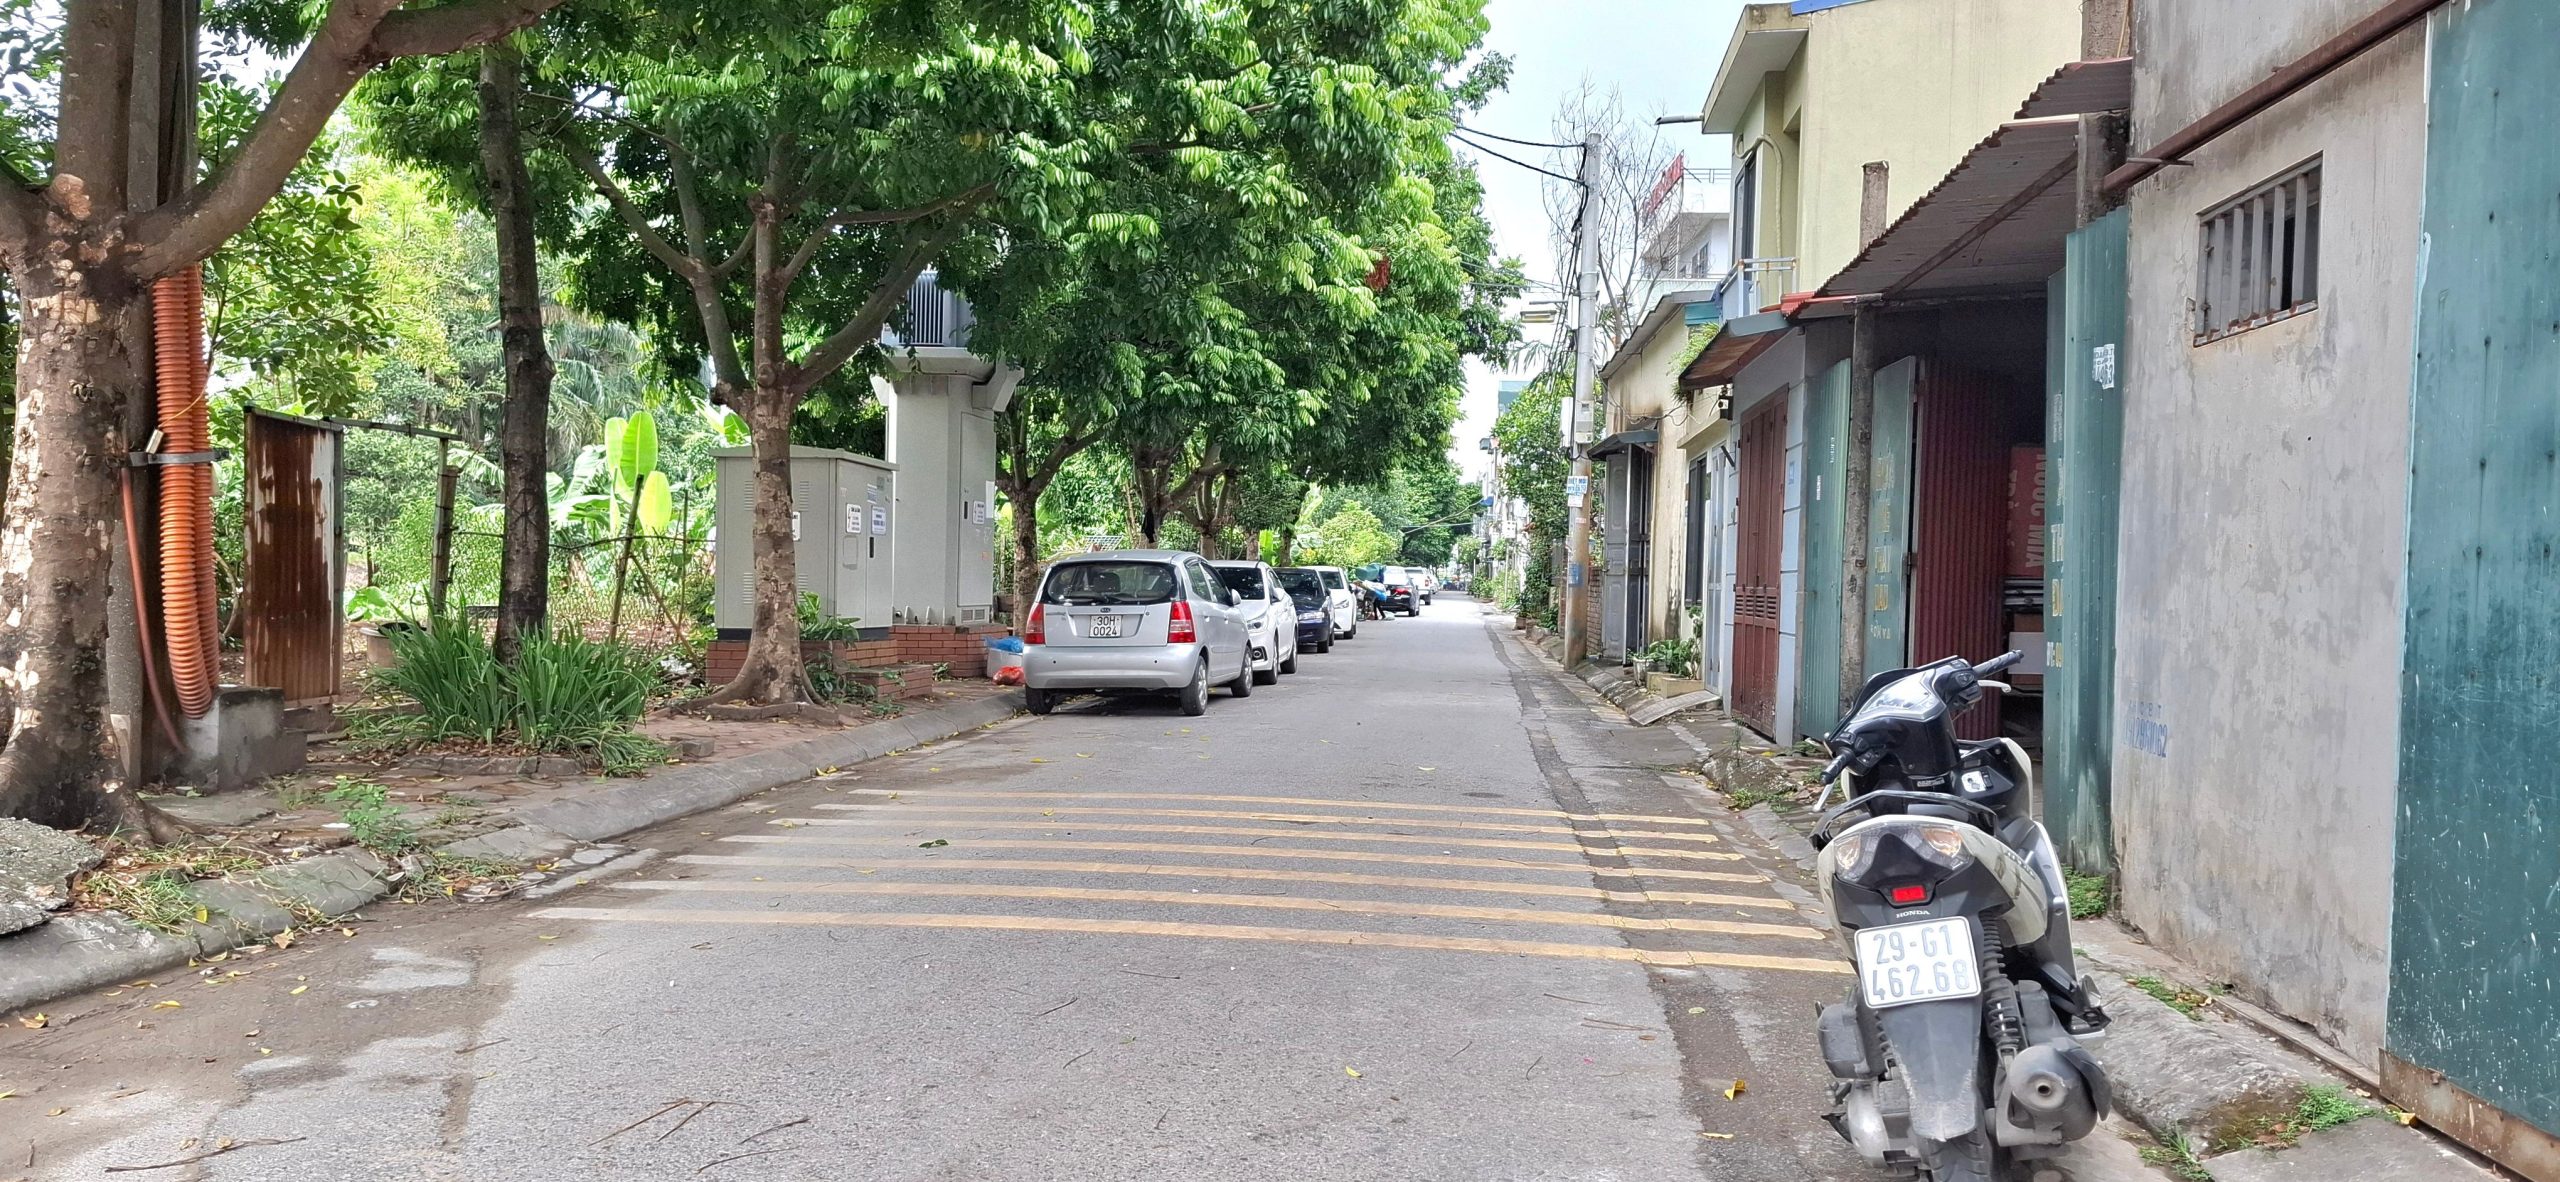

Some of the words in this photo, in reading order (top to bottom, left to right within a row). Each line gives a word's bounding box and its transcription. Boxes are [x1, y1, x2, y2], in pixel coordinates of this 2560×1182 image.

[1097, 616, 1115, 626] 30H
[1093, 627, 1117, 636] 0024
[1896, 910, 1930, 918] HONDA
[1873, 925, 1953, 964] 29-G1
[1873, 960, 1970, 1000] 462.68
